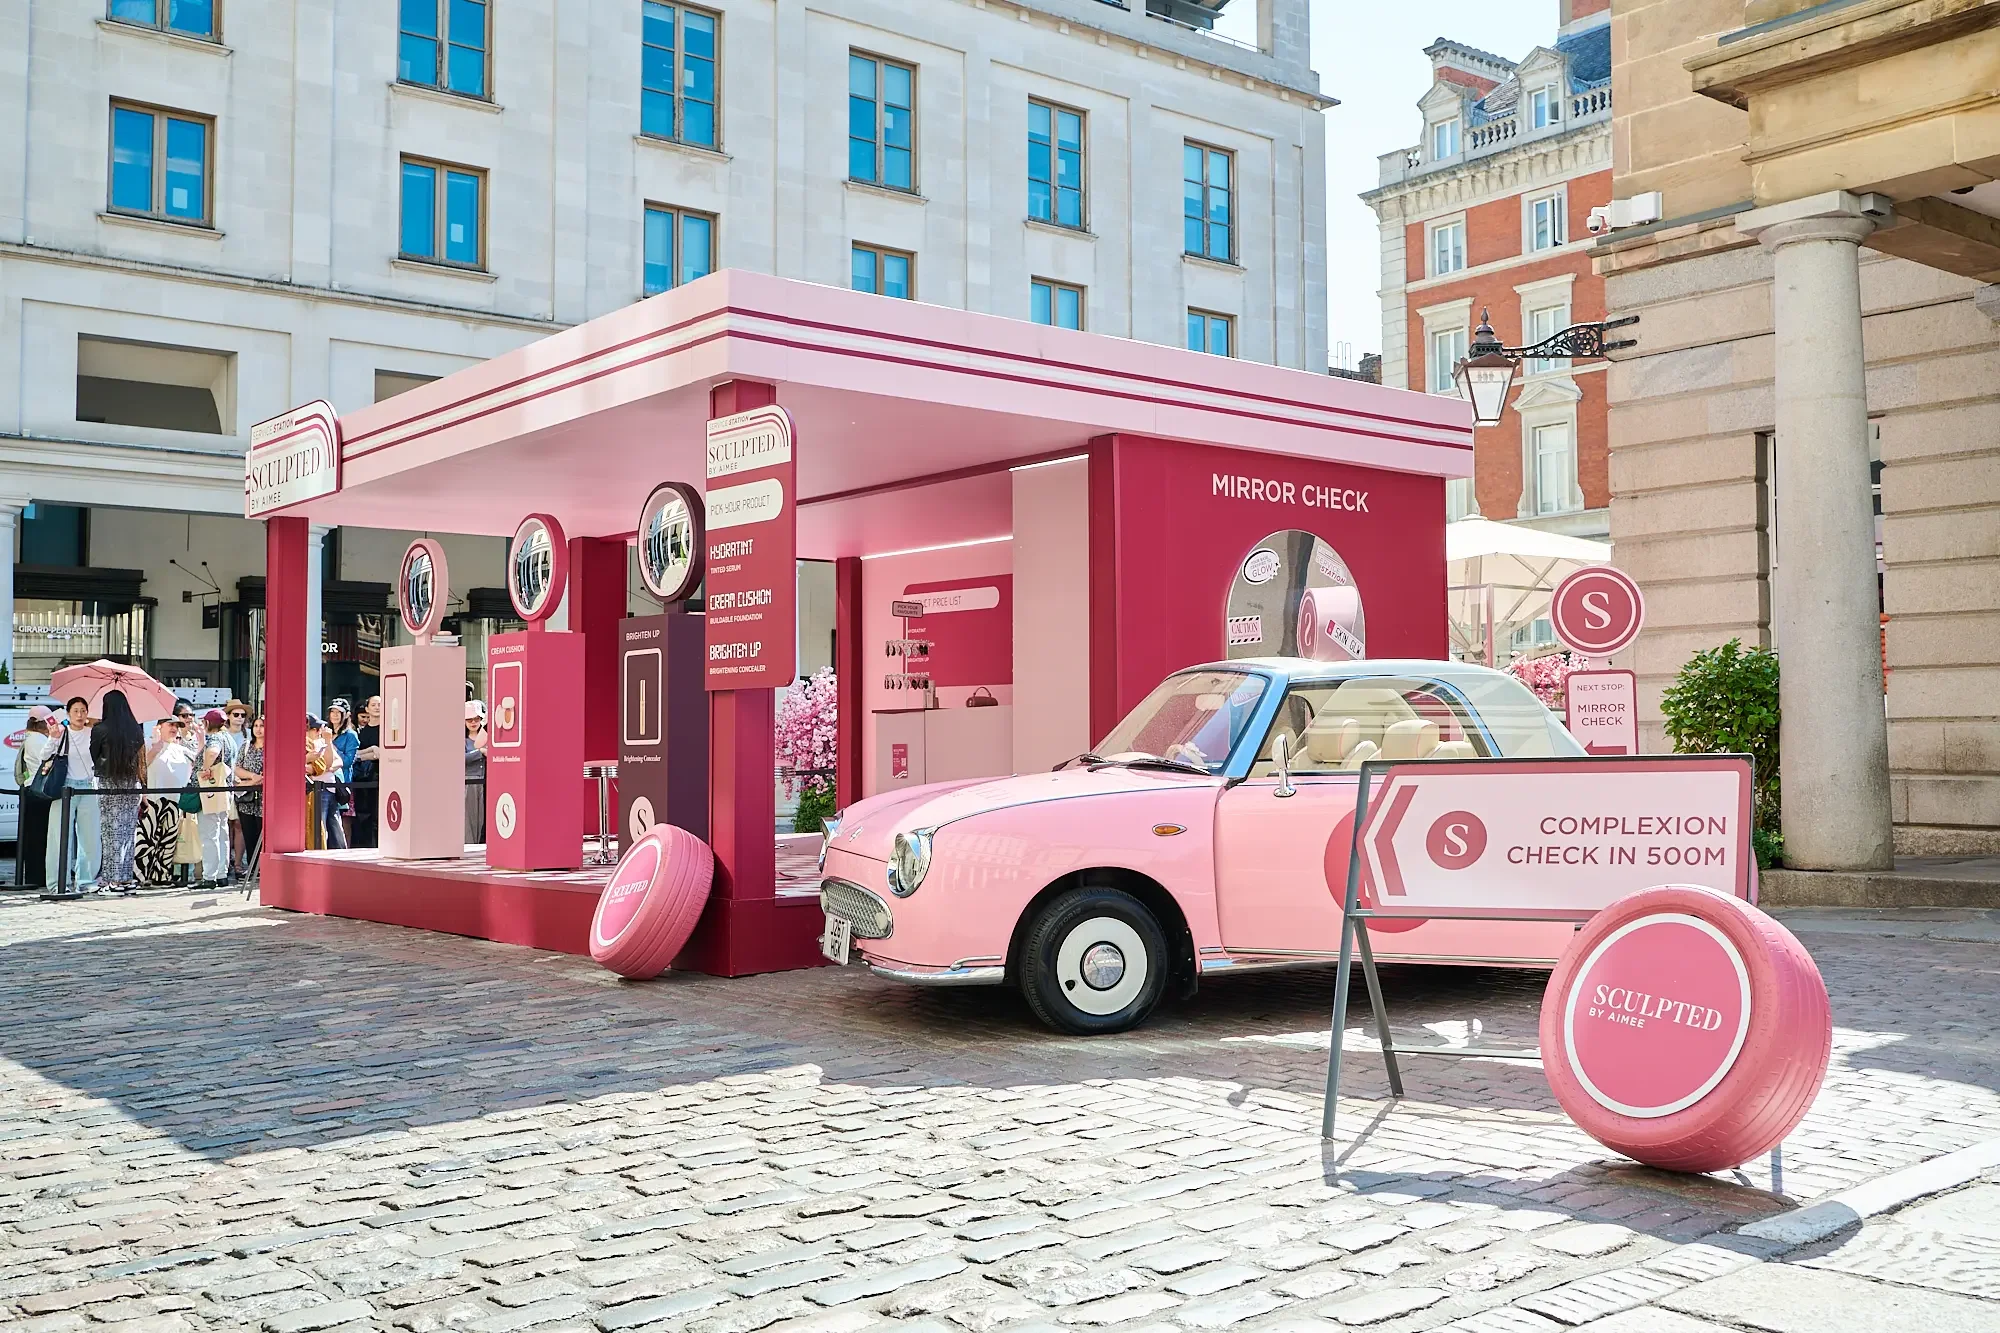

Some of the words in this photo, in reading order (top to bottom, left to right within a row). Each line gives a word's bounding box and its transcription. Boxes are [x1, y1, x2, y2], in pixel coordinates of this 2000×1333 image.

[273, 418, 294, 434] STATION
[728, 416, 748, 426] STATION
[708, 434, 775, 464] SCULPTED
[252, 446, 320, 492] SCULPTED
[709, 466, 716, 475] BY
[719, 462, 738, 472] AIMEE
[252, 500, 259, 510] BY
[262, 492, 281, 505] AIMEE
[1212, 473, 1296, 504] MIRROR
[1302, 484, 1369, 512] CHECK
[710, 504, 723, 516] PICK
[725, 500, 740, 513] YOUR
[742, 495, 770, 510] PRODUCT
[710, 539, 754, 560] HYDRATINT
[710, 566, 726, 574] TINTED
[726, 564, 741, 572] SERUM
[1252, 563, 1272, 578] GLOW
[1321, 566, 1345, 584] STATION
[710, 592, 735, 610] CREAM
[738, 589, 772, 607] CUSHION
[710, 616, 733, 625] BUILDABLE
[734, 613, 762, 622] FOUNDATION
[1582, 592, 1612, 630] S
[626, 631, 651, 641] BRIGHTEN
[652, 629, 660, 638] UP
[1232, 622, 1258, 634] CAUTION
[1335, 627, 1348, 645] SKIN
[320, 642, 339, 653] OR
[491, 646, 505, 656] CREAM
[506, 644, 524, 654] CUSHION
[710, 643, 747, 660] BRIGHTEN
[750, 641, 761, 658] UP
[710, 667, 738, 675] BRIGHTENING
[738, 665, 766, 673] CONCEALER
[1578, 704, 1625, 713] MIRROR
[1582, 716, 1623, 726] CHECK
[390, 800, 398, 823] S
[502, 803, 510, 828] S
[637, 808, 646, 836] S
[1540, 816, 1727, 836] COMPLEXION
[1443, 823, 1470, 857] S
[1507, 846, 1600, 865] CHECK
[1609, 847, 1636, 865] IN
[1646, 846, 1725, 866] 500M
[613, 880, 648, 898] SCULPTED
[1592, 984, 1723, 1032] SCULPTED
[1588, 1008, 1604, 1018] BY
[1607, 1012, 1645, 1029] AIMEE
